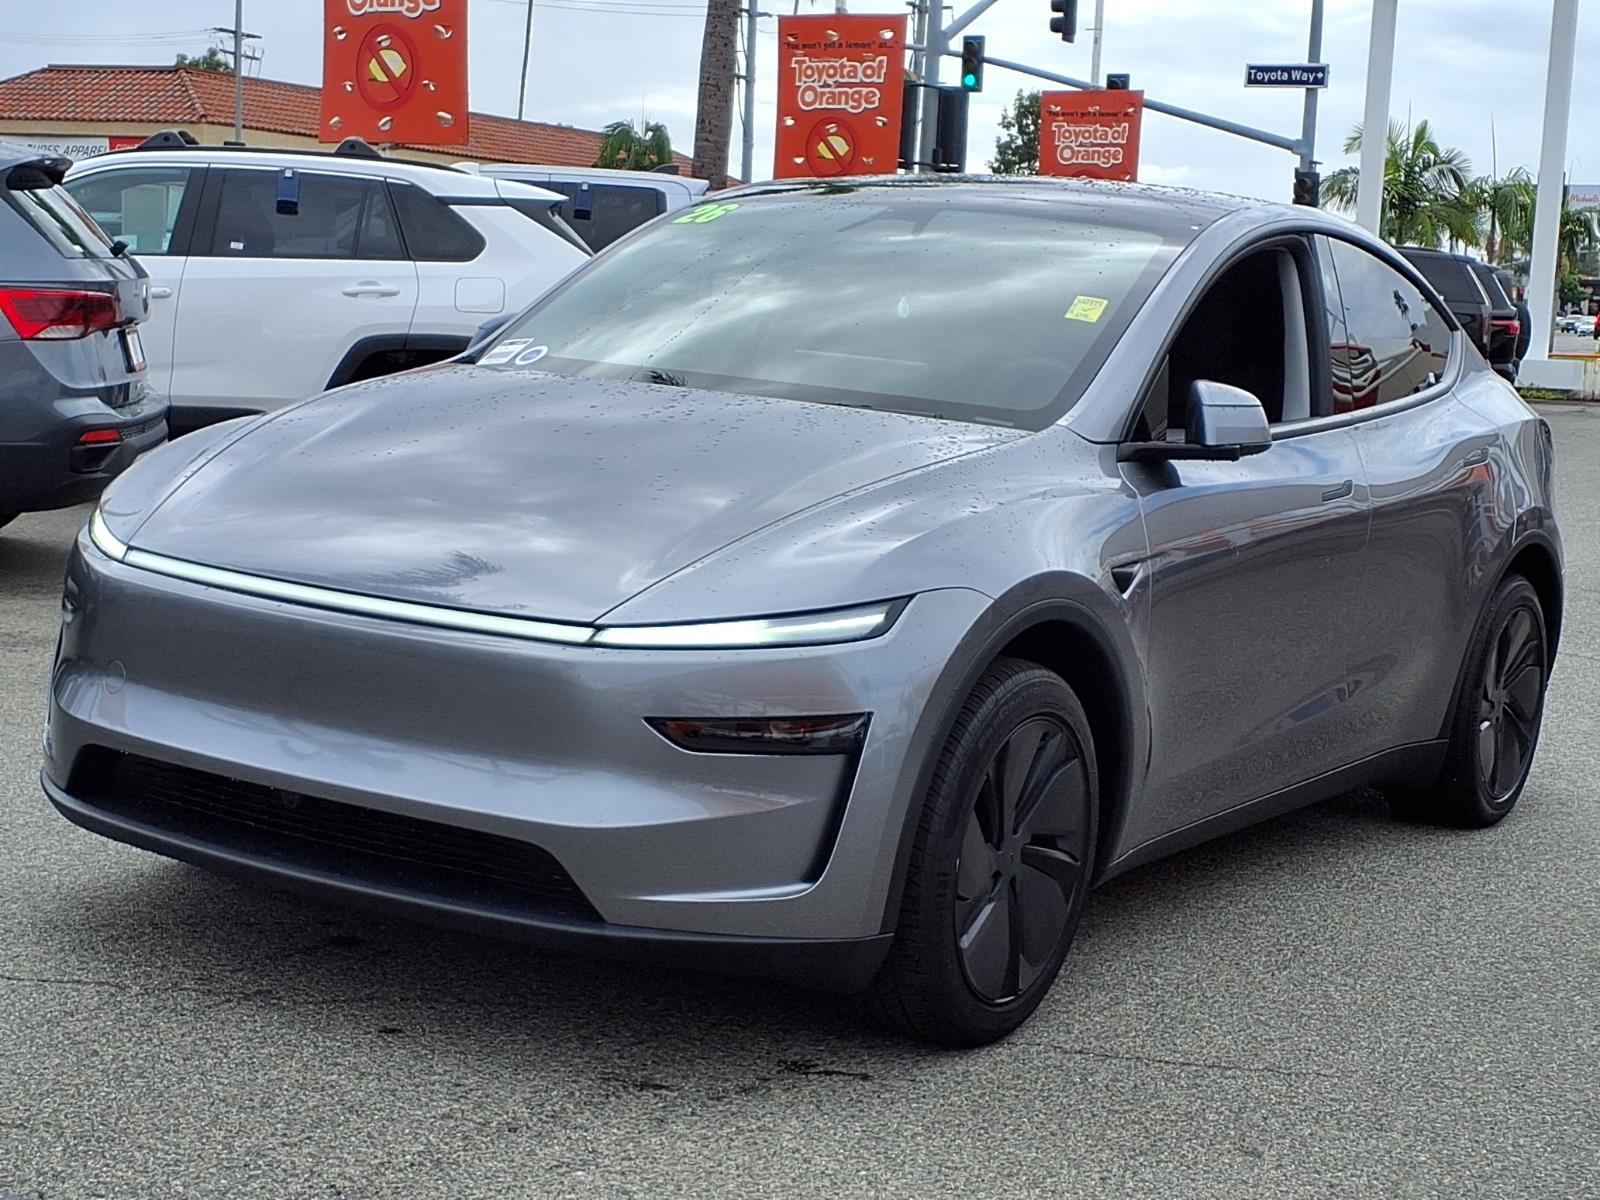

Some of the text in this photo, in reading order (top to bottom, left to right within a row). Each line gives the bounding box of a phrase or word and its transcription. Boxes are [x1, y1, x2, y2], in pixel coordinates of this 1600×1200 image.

[791, 55, 887, 86] Toyota of
[1249, 69, 1316, 83] Toyota Way
[798, 83, 880, 113] Orange
[1051, 122, 1129, 146] Toyota of
[1057, 144, 1123, 168] Orange
[671, 203, 740, 224] 26
